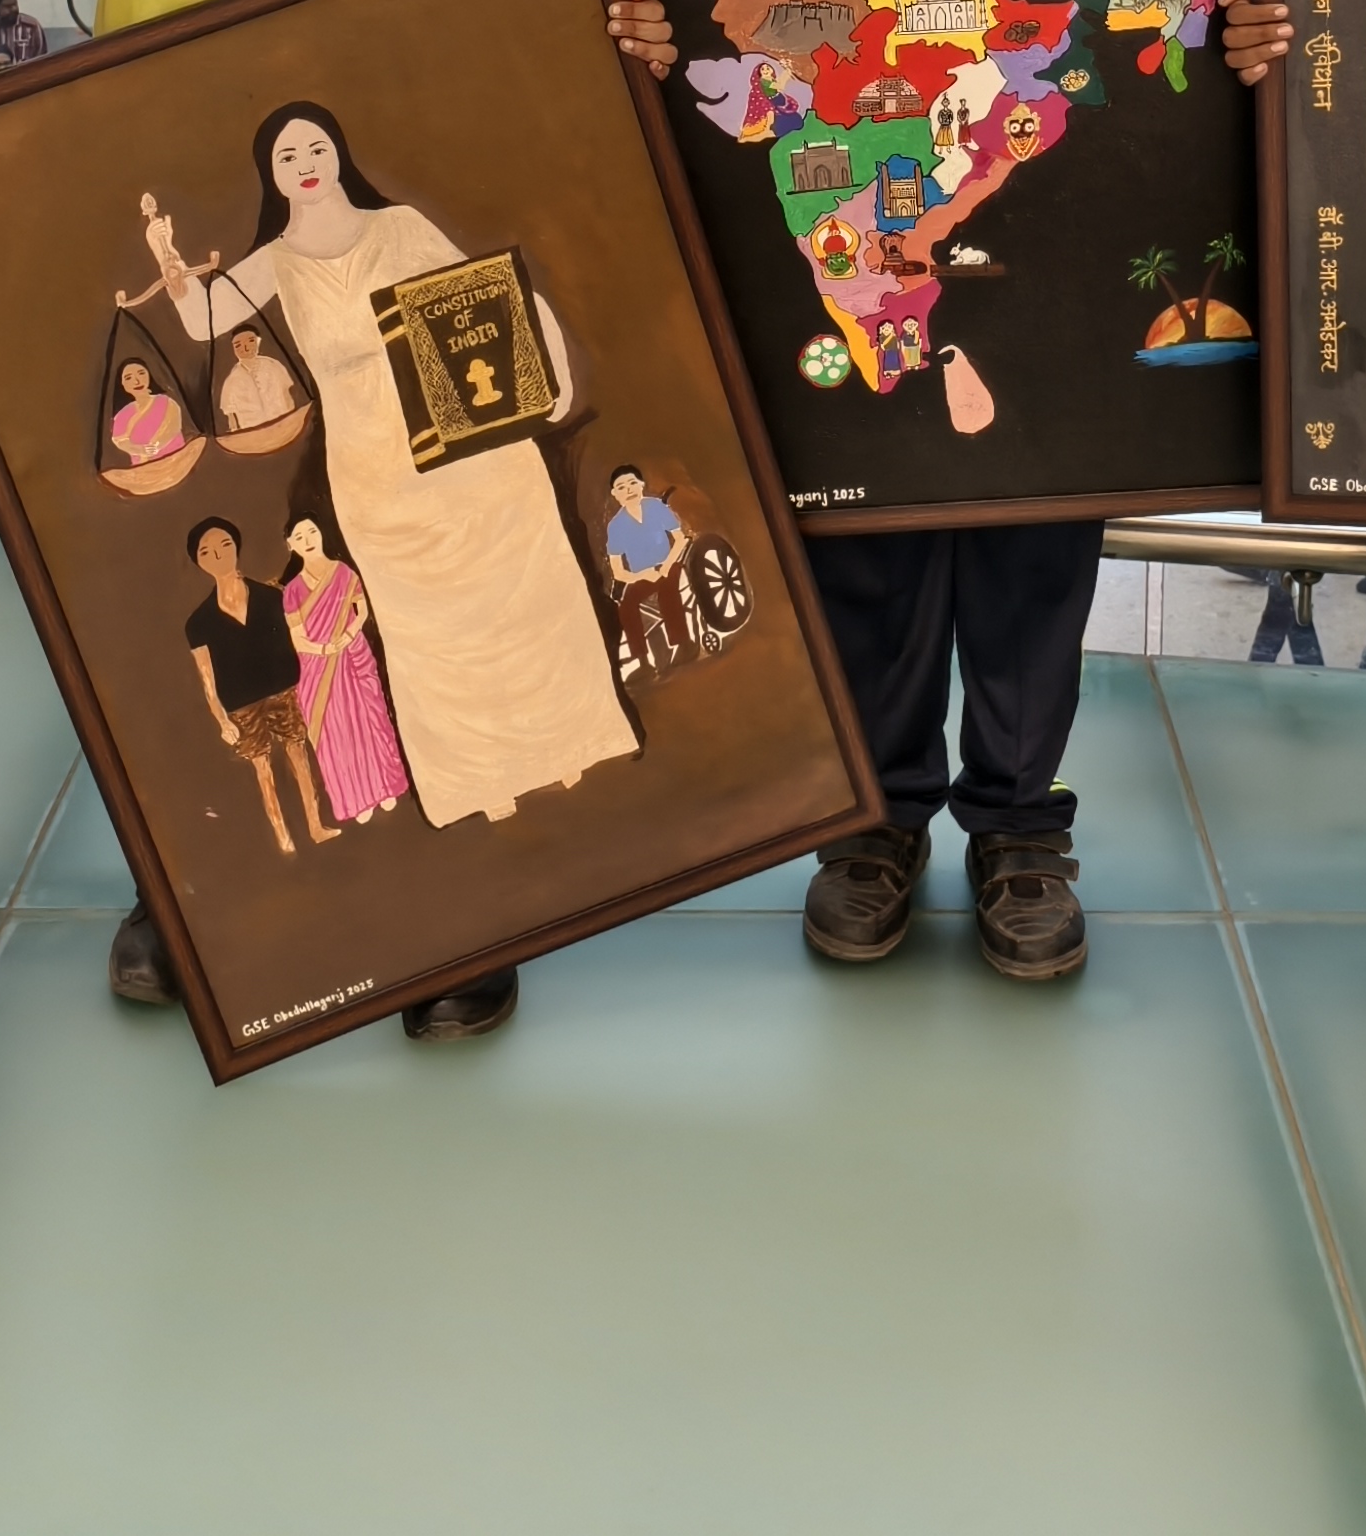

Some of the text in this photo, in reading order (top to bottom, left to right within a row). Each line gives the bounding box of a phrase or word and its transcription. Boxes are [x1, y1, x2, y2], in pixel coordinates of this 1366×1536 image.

[1305, 30, 1341, 112] संविधान
[453, 308, 474, 329] OF
[447, 322, 499, 353] INDIA
[832, 487, 865, 501] 2025
[1309, 477, 1338, 492] GSE
[242, 978, 374, 1037] GSE Obedullaganj 2025
